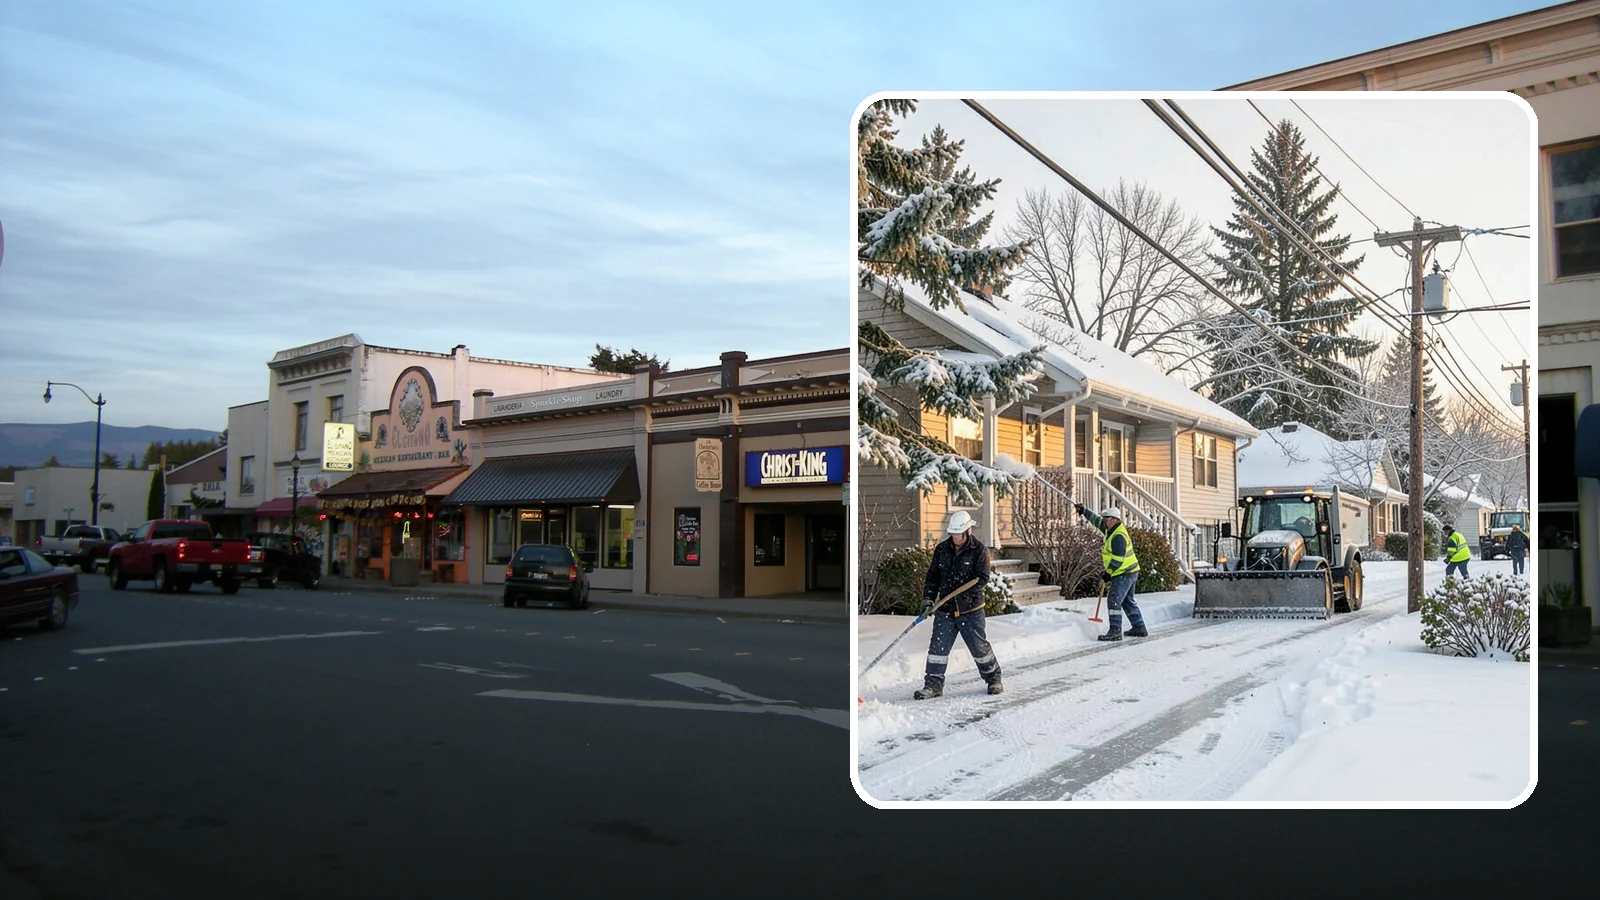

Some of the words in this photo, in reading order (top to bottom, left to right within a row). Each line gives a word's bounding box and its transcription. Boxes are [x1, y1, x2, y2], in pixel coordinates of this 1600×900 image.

[530, 397, 561, 409] Sparkle
[561, 394, 583, 405] Shop
[595, 389, 623, 400] LAUNDRY
[493, 402, 522, 413] LAVANDERIA
[392, 425, 401, 449] EL
[373, 455, 396, 464] MEXICAN
[397, 451, 433, 462] RESTAURANT
[438, 450, 450, 459] BAR
[761, 452, 797, 478] CHRIST
[799, 450, 827, 476] KING
